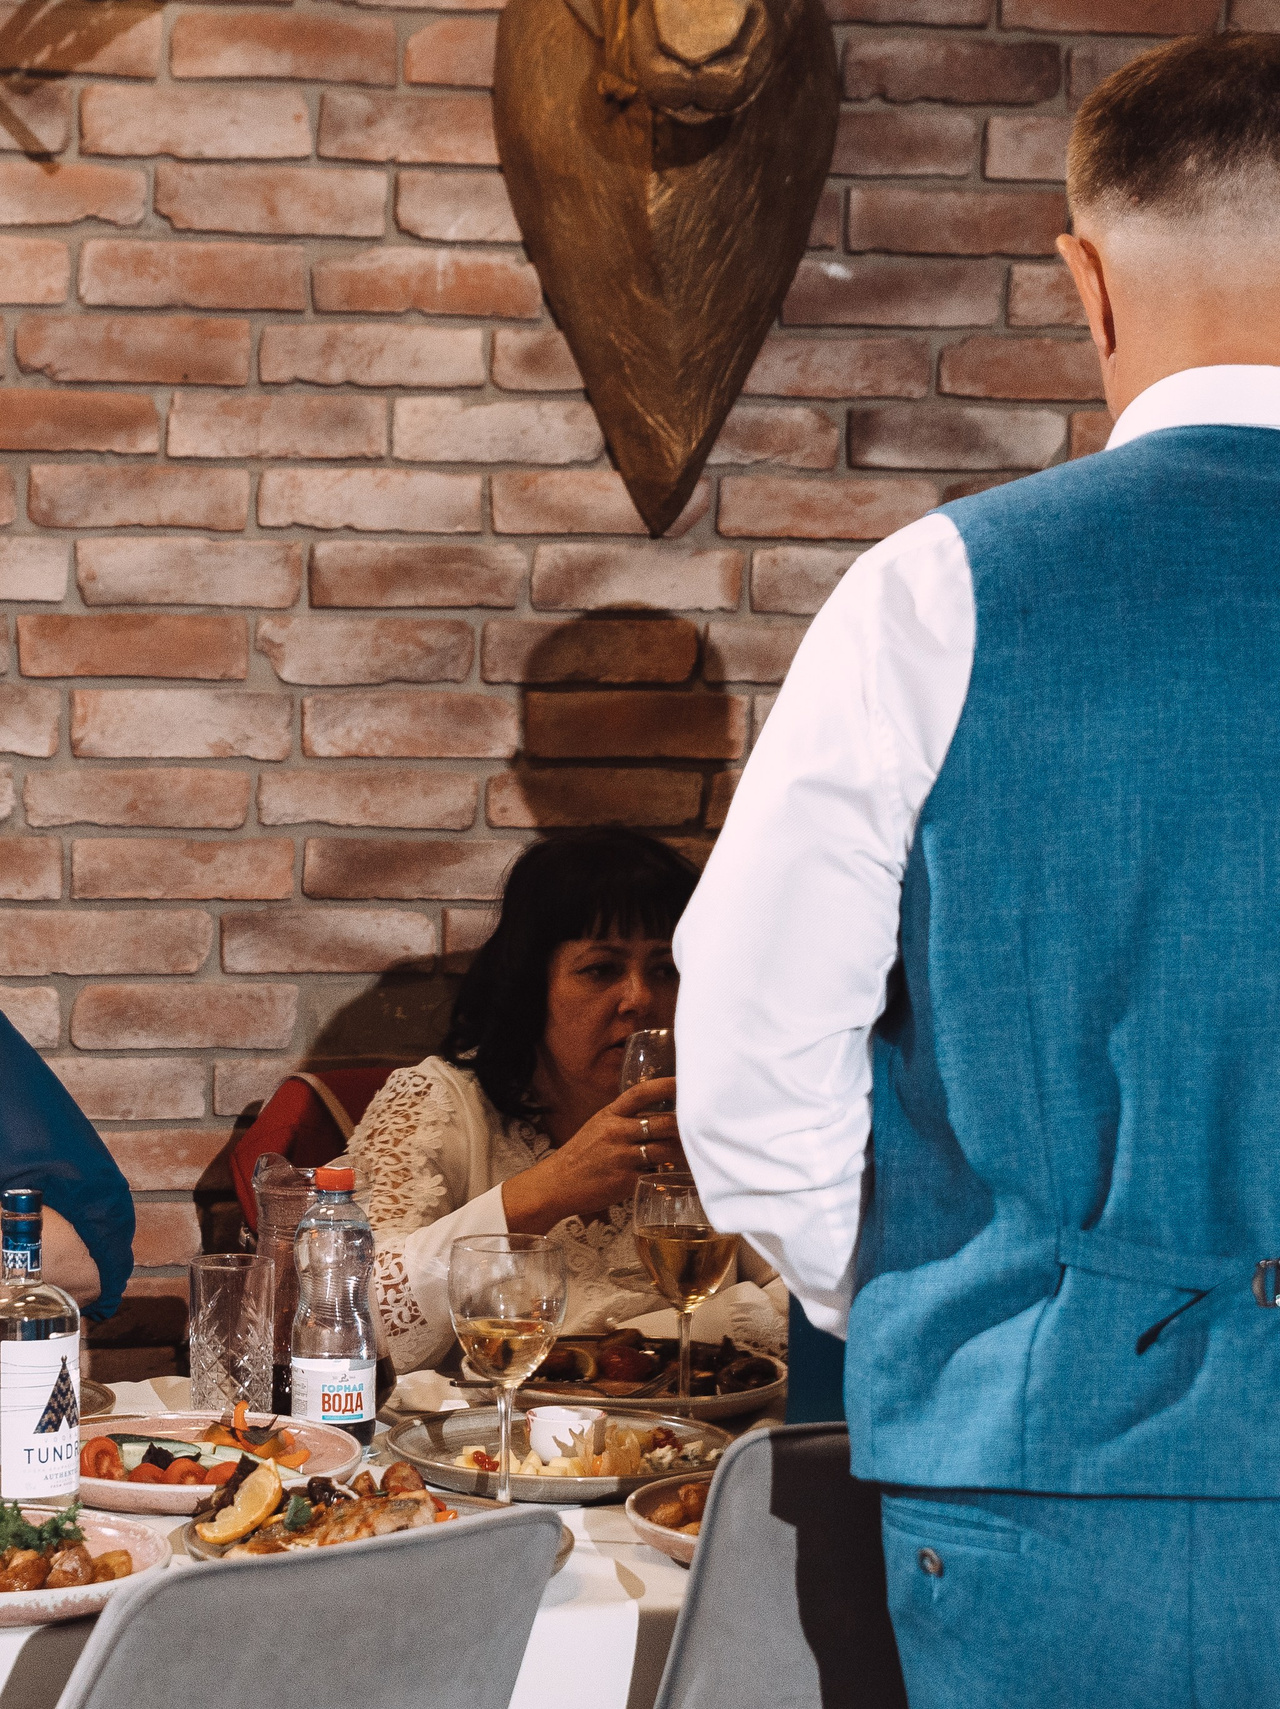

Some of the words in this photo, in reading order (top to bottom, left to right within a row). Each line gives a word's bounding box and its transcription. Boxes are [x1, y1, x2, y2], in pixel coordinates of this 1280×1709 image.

[322, 1383, 364, 1392] ГОРНАЯ
[322, 1392, 363, 1414] ВОДА
[23, 1440, 79, 1464] TUNDR
